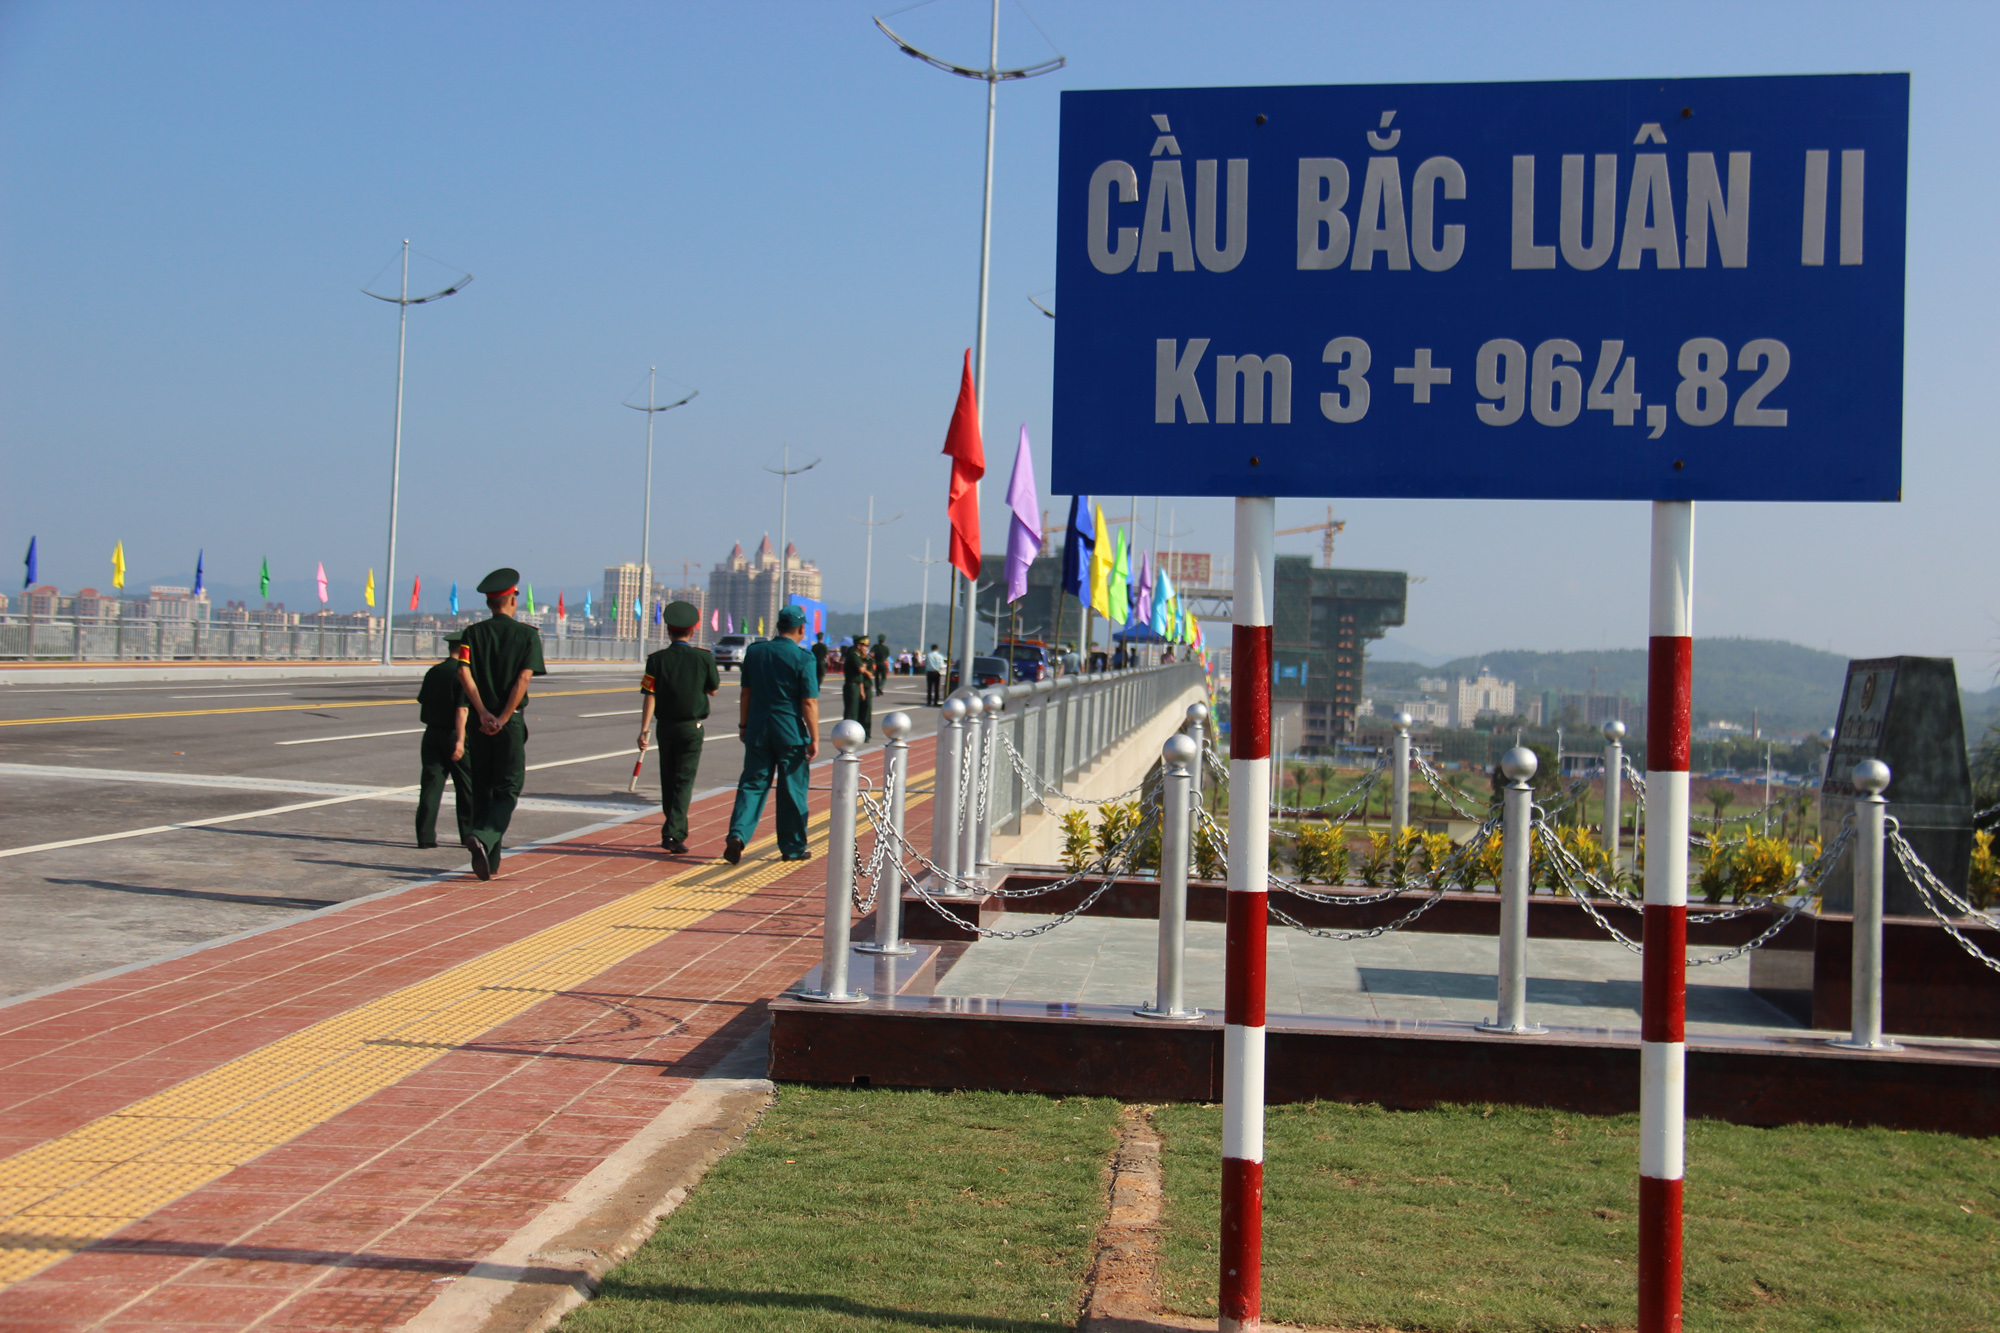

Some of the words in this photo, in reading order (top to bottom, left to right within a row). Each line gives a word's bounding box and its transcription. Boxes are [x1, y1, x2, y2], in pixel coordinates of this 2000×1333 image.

[1086, 113, 1249, 274] CẦU
[1296, 110, 1467, 272] BẮC
[1511, 123, 1751, 272] LUÂN
[1801, 149, 1864, 266] II
[1154, 338, 1292, 425] Km
[1319, 336, 1371, 424] 3
[1393, 348, 1452, 404] +
[1475, 337, 1791, 439] 964,82
